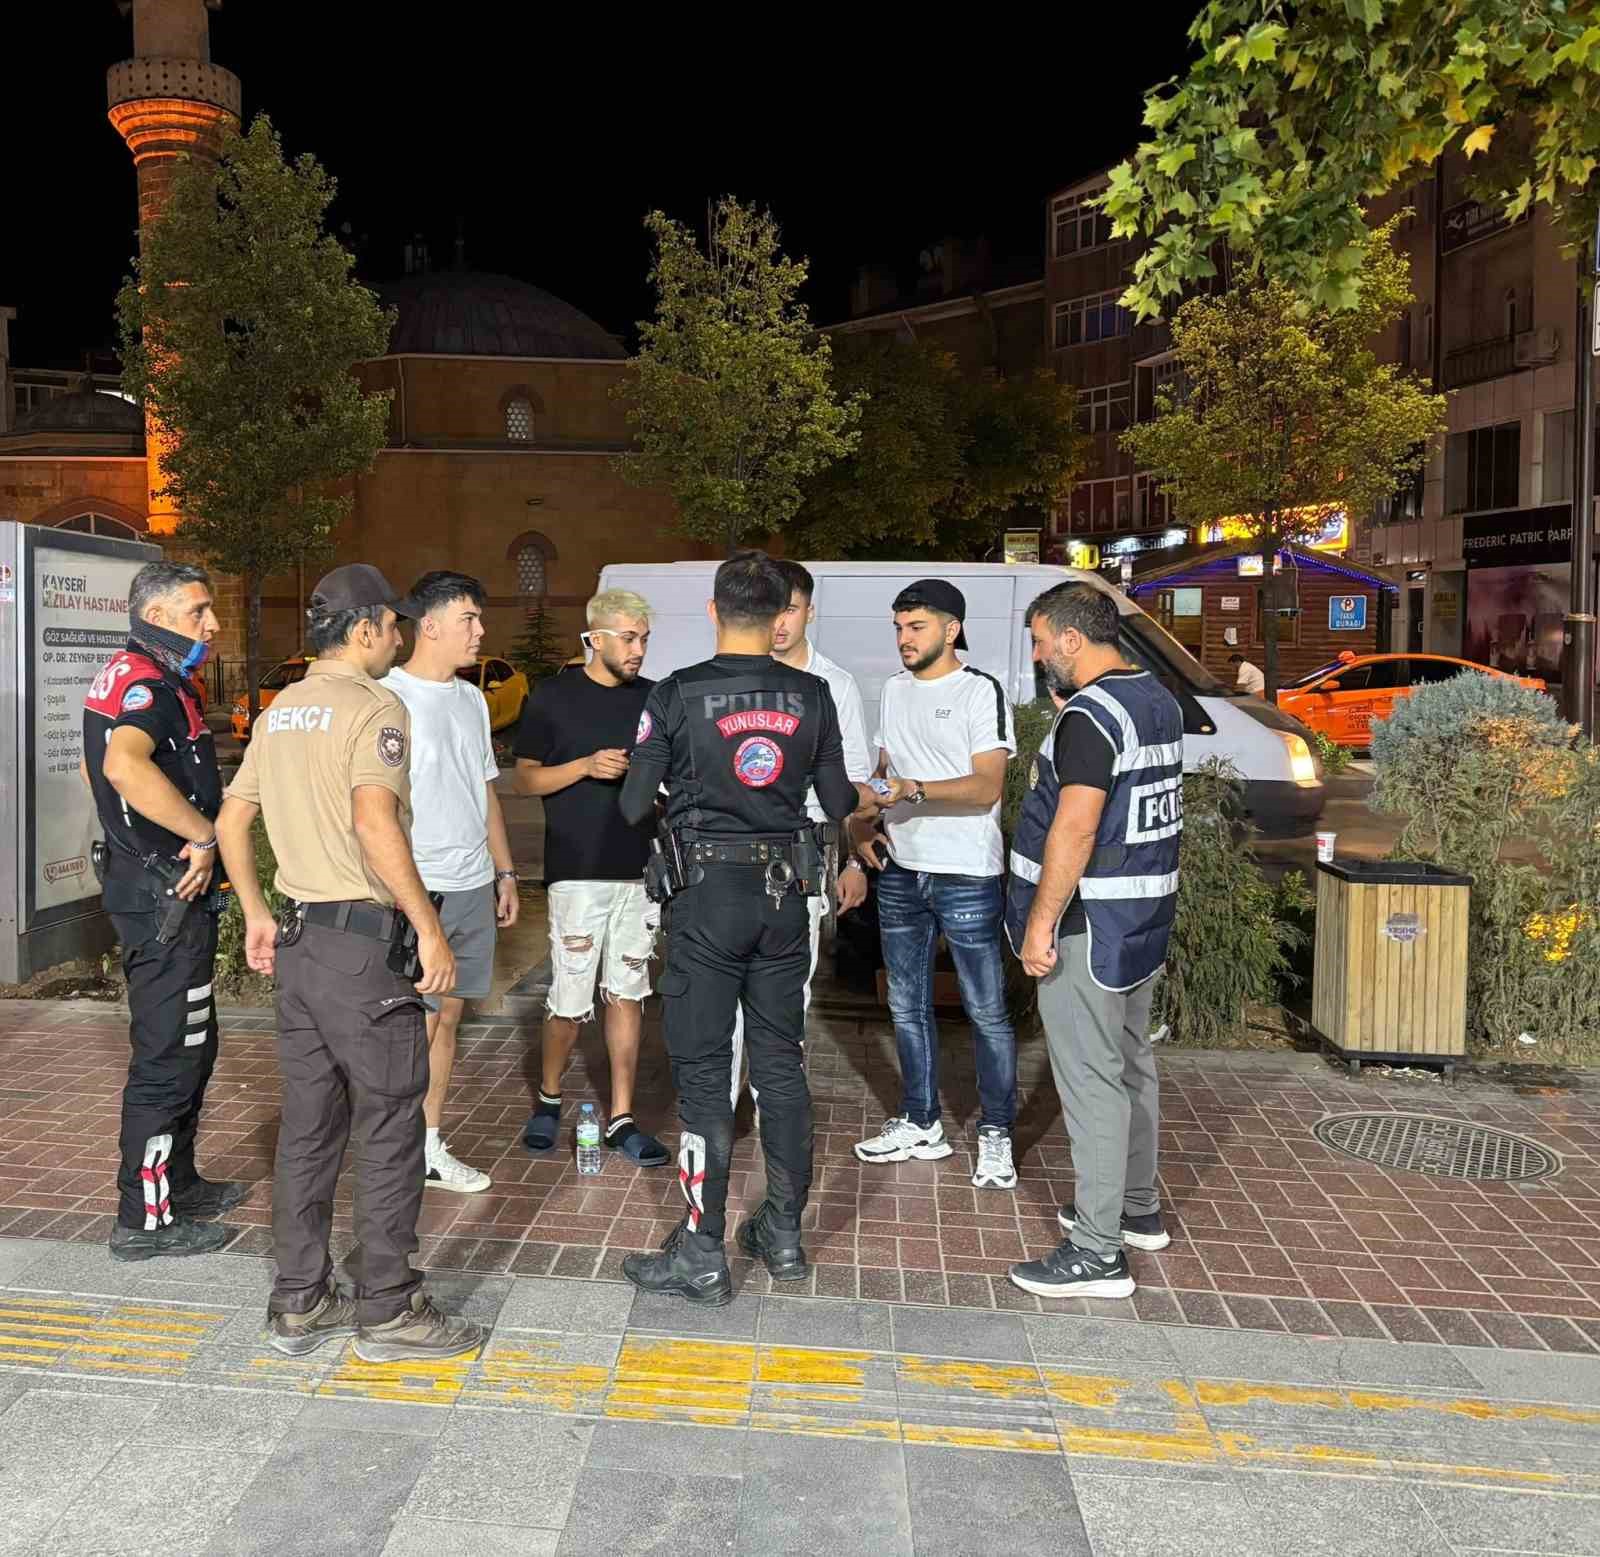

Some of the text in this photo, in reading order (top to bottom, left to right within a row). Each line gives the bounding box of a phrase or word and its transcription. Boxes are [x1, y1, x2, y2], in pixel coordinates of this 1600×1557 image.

[1464, 535, 1506, 549] FREDERIC
[1510, 531, 1544, 545] PATRIC
[42, 574, 87, 593] KAYSERİ
[45, 631, 60, 643] GÖZ
[69, 653, 95, 664] ZEYNEP
[267, 706, 334, 733] BEKÇİ
[720, 711, 795, 736] YUNUSLAR
